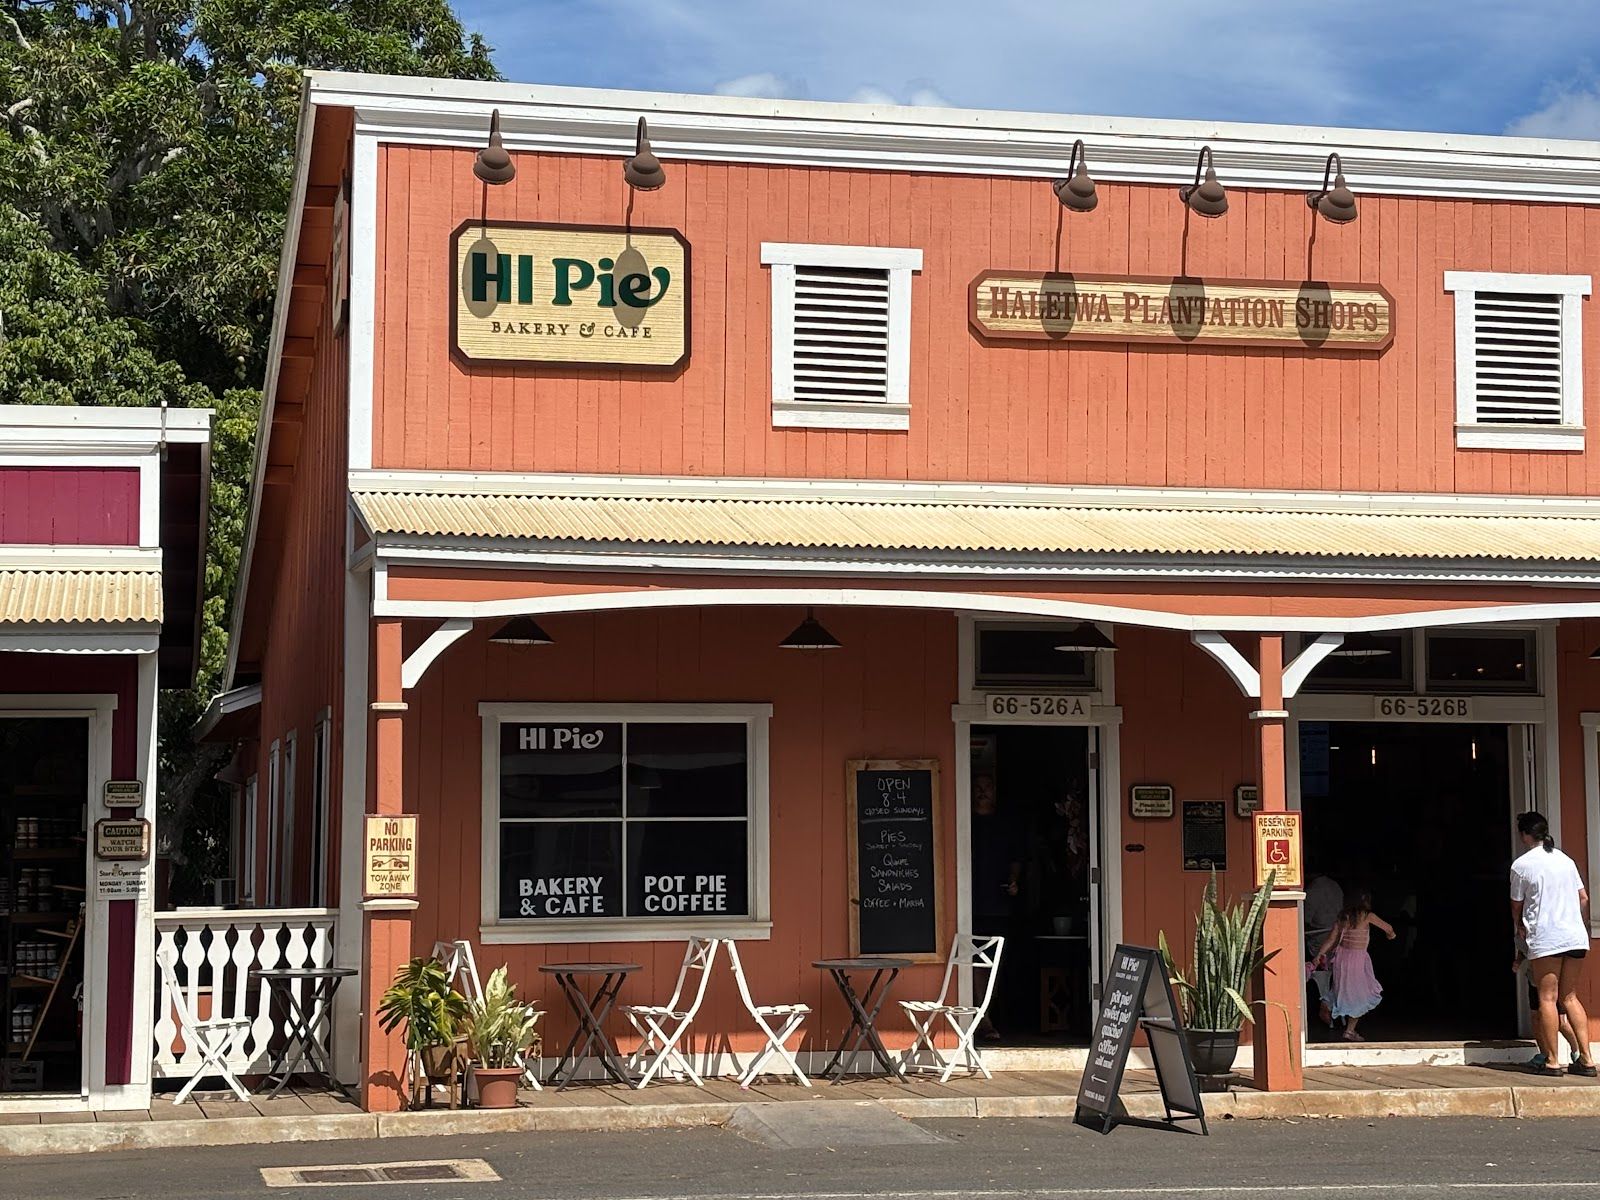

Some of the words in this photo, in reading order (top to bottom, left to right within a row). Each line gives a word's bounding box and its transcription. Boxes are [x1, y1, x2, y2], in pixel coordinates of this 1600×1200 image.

[472, 252, 533, 305] HI
[552, 257, 670, 308] Pie
[989, 286, 1112, 323] HALEIWA
[1123, 291, 1284, 328] PLANTATION
[1296, 296, 1378, 332] SHOPS
[491, 321, 570, 336] BAKERY
[579, 322, 595, 338] &
[604, 325, 652, 339] CAFE
[992, 697, 1084, 715] 66-526A
[1381, 698, 1467, 716] 66-526B
[519, 727, 546, 750] HI
[553, 727, 604, 750] Pie
[877, 777, 911, 792] OPEN
[384, 822, 398, 836] NO
[1258, 816, 1296, 828] RESERVED
[105, 826, 141, 836] CAUTION
[880, 829, 907, 843] PIES
[1261, 827, 1294, 838] PARKING
[102, 845, 123, 853] YOUR
[124, 845, 144, 853] STEP
[370, 837, 412, 851] PARKING
[370, 874, 388, 882] TOW
[388, 874, 410, 882] AWAY
[379, 882, 401, 890] ZONE
[644, 875, 686, 893] POT
[695, 874, 727, 892] PIE
[519, 876, 603, 897] BAKERY
[519, 898, 537, 916] &
[545, 896, 604, 915] CAFE
[644, 894, 727, 912] COFFEE
